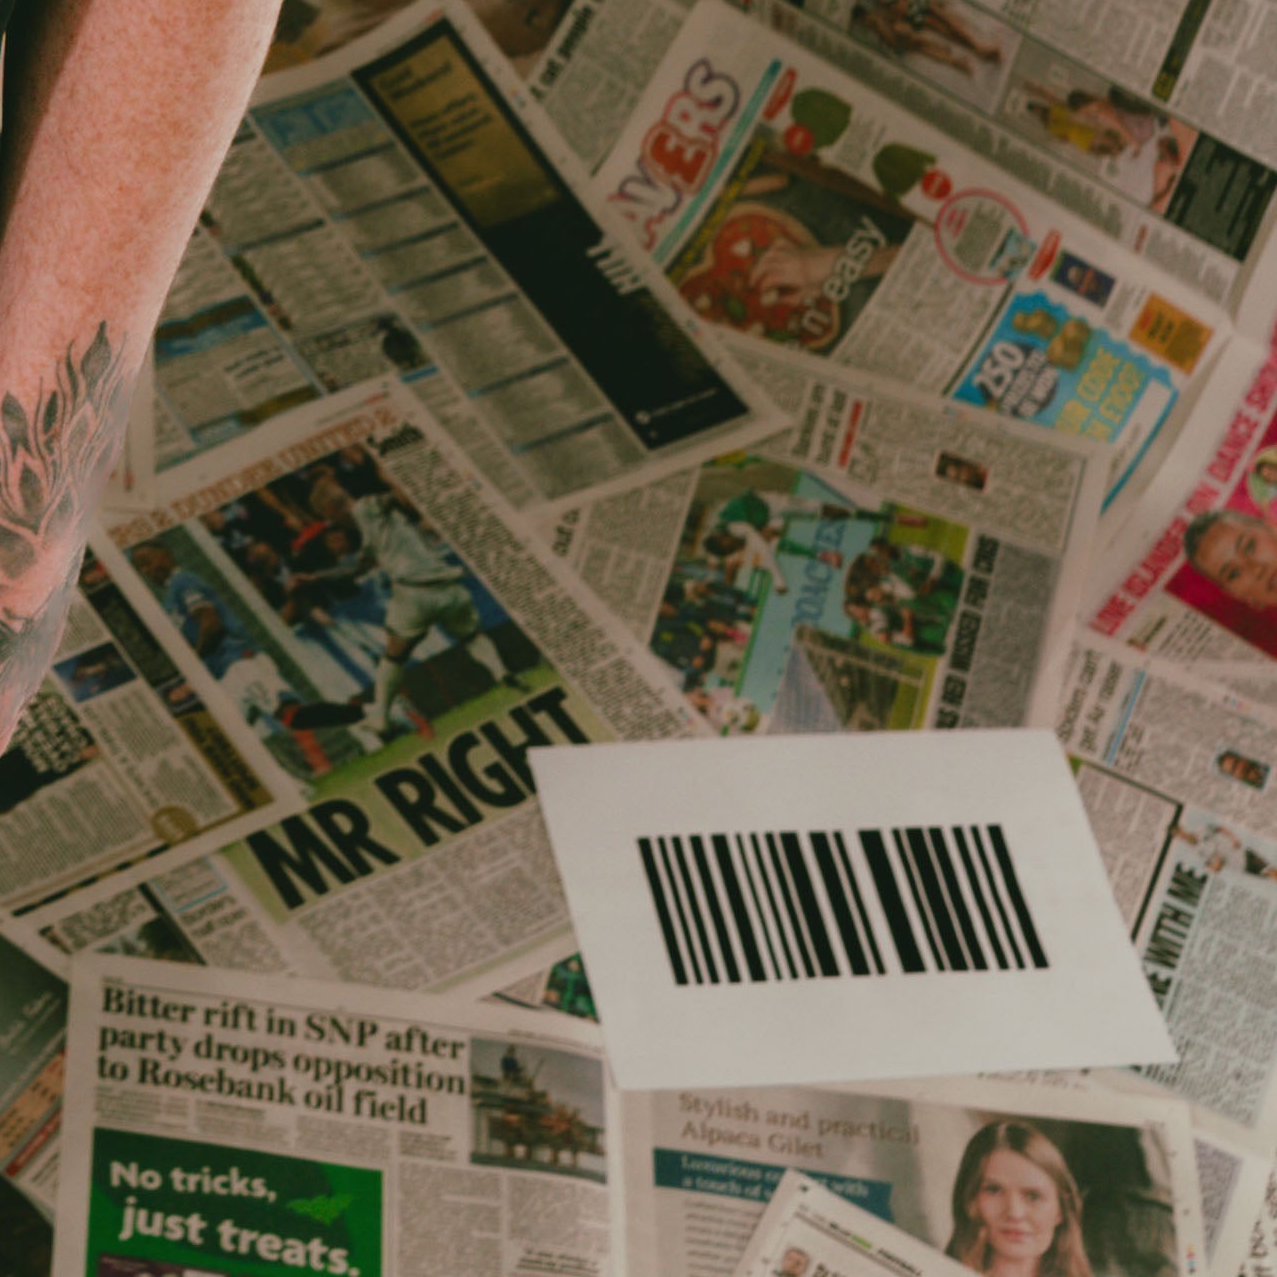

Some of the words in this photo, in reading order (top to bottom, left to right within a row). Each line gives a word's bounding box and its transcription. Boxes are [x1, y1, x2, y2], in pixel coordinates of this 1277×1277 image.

[818, 218, 886, 302] easy
[972, 345, 1025, 398] 250
[247, 799, 397, 907] MR
[376, 688, 585, 844] RIGHT
[1166, 862, 1208, 906] ME
[1144, 902, 1193, 969] WITH
[102, 985, 195, 1022] Bitter
[202, 1000, 256, 1031] rift
[265, 1009, 296, 1037] in
[305, 1014, 378, 1047] SNP
[384, 1025, 465, 1059] after
[96, 1054, 129, 1081] to
[137, 1056, 294, 1104] Rosebank
[303, 1075, 343, 1112] oil
[353, 1089, 427, 1125] field
[98, 1026, 182, 1061] party
[192, 1032, 285, 1071] drops
[292, 1054, 465, 1094] opposition
[678, 1092, 760, 1123] Stylish
[764, 1109, 810, 1129] and
[817, 1116, 918, 1148] practical
[680, 1120, 761, 1149] Alpaca
[767, 1133, 825, 1161] Gilet
[109, 1160, 162, 1190] No
[170, 1166, 276, 1202] tricks,
[118, 1196, 206, 1244] just
[218, 1220, 359, 1277] treats.
